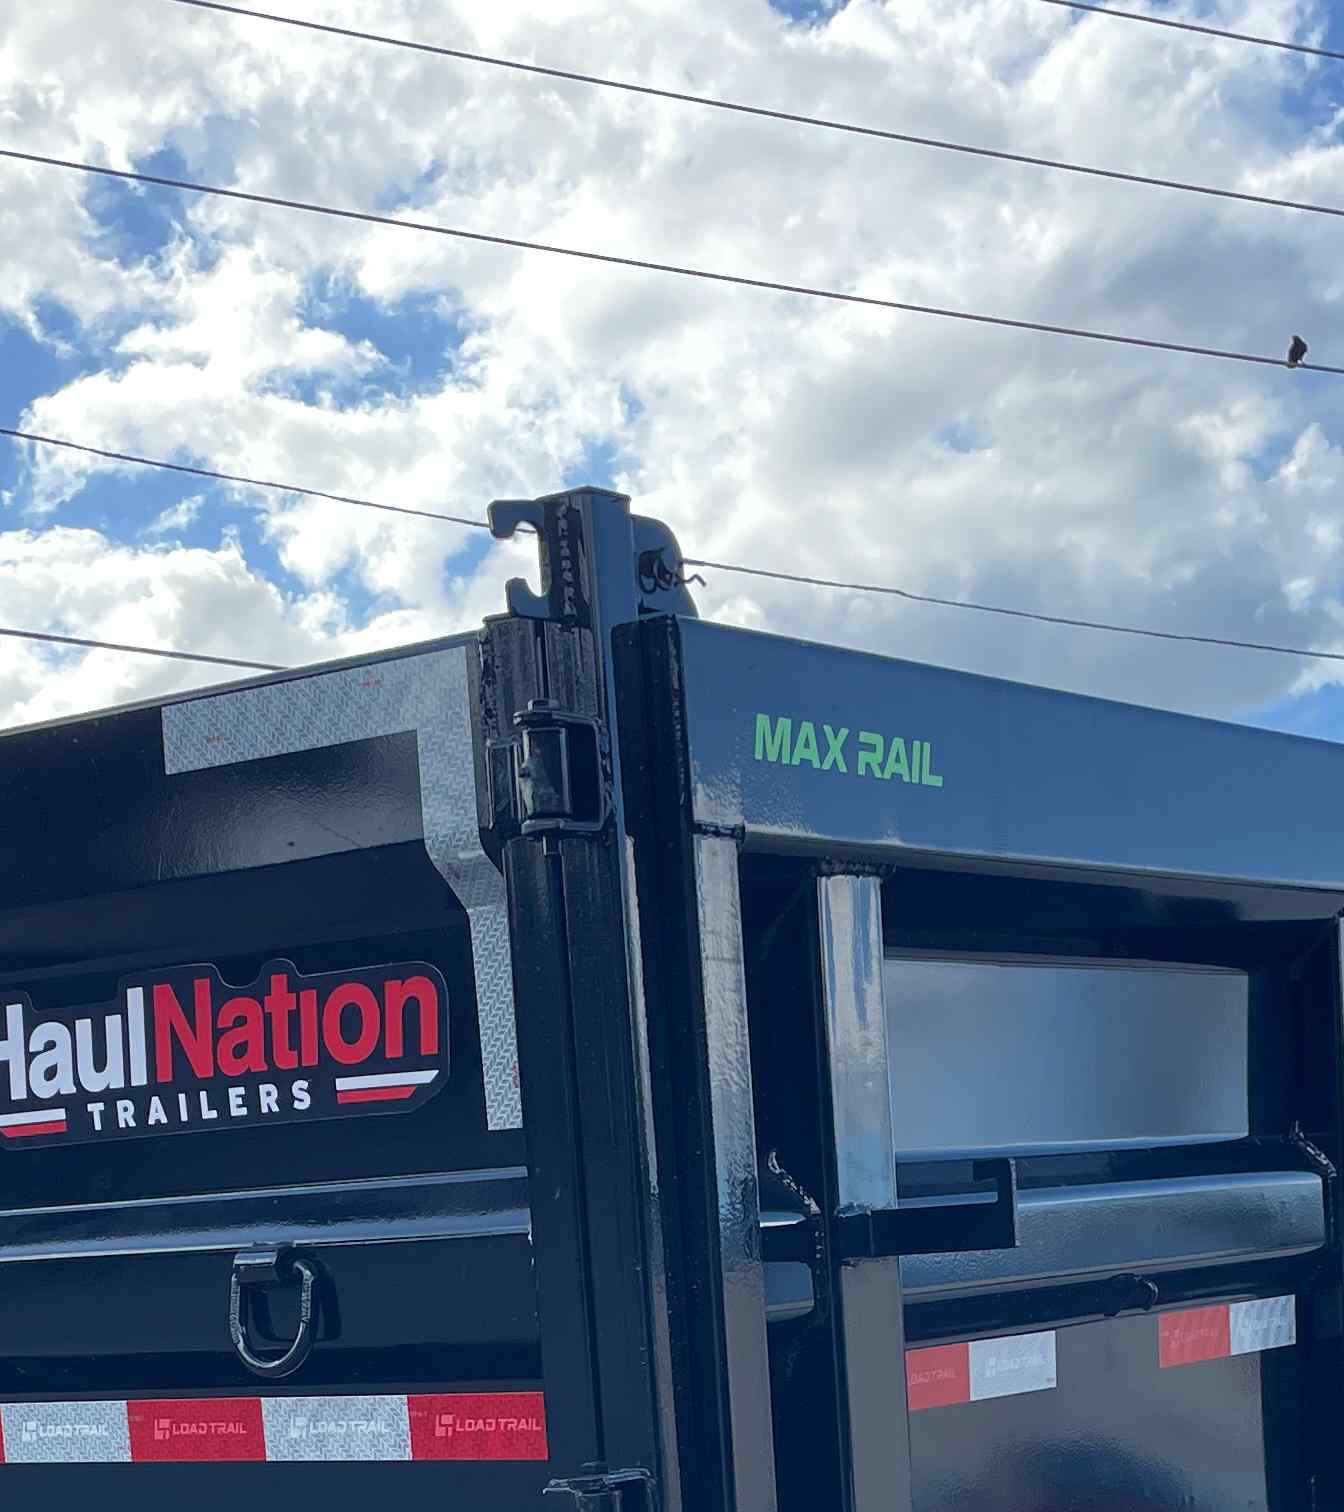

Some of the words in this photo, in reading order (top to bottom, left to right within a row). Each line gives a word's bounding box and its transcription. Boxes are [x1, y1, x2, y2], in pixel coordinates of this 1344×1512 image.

[755, 713, 849, 773] MAX
[858, 731, 944, 787] RAIL
[87, 1079, 313, 1132] TRAILERS
